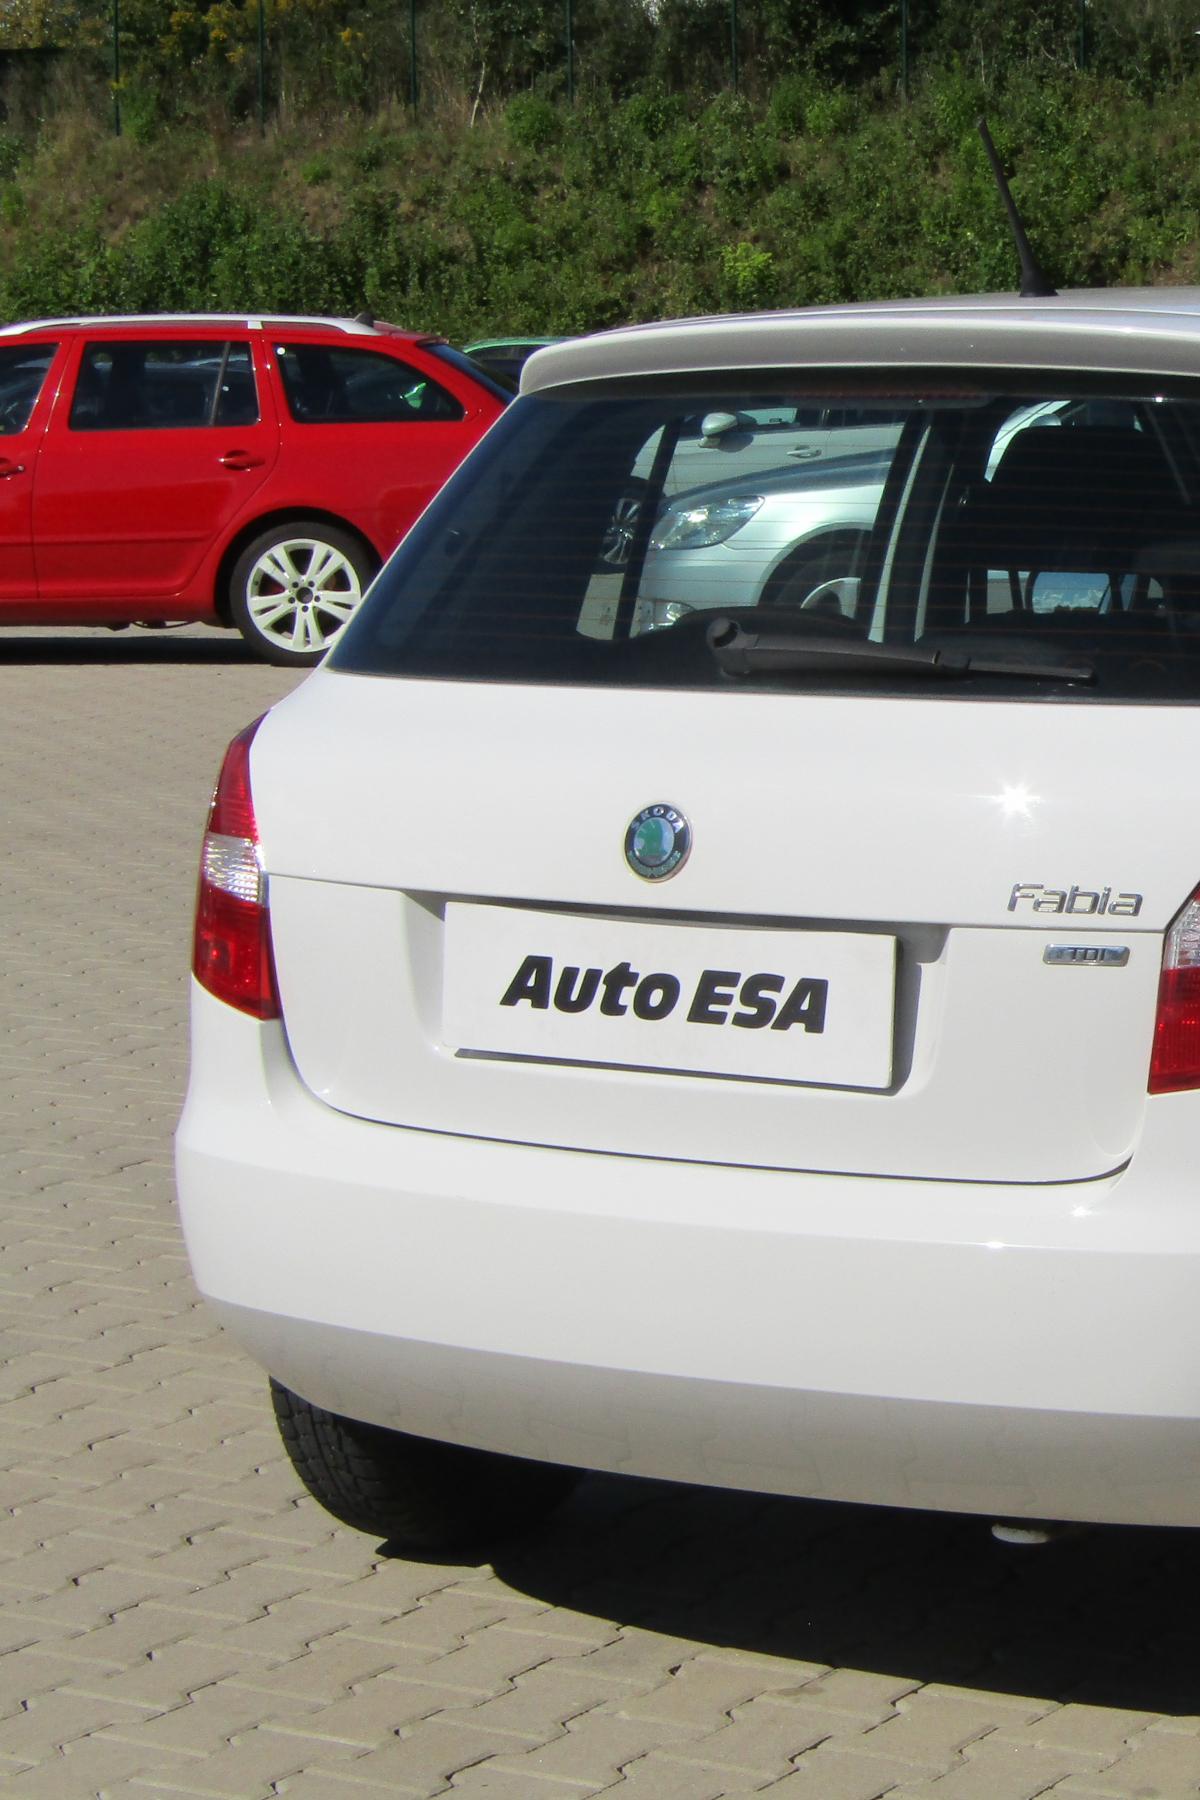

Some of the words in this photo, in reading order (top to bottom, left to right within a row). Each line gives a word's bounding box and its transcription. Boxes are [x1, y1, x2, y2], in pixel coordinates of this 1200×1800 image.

[1007, 883, 1144, 917] Fabia
[500, 955, 681, 1020] Auto
[686, 969, 829, 1034] ESA
